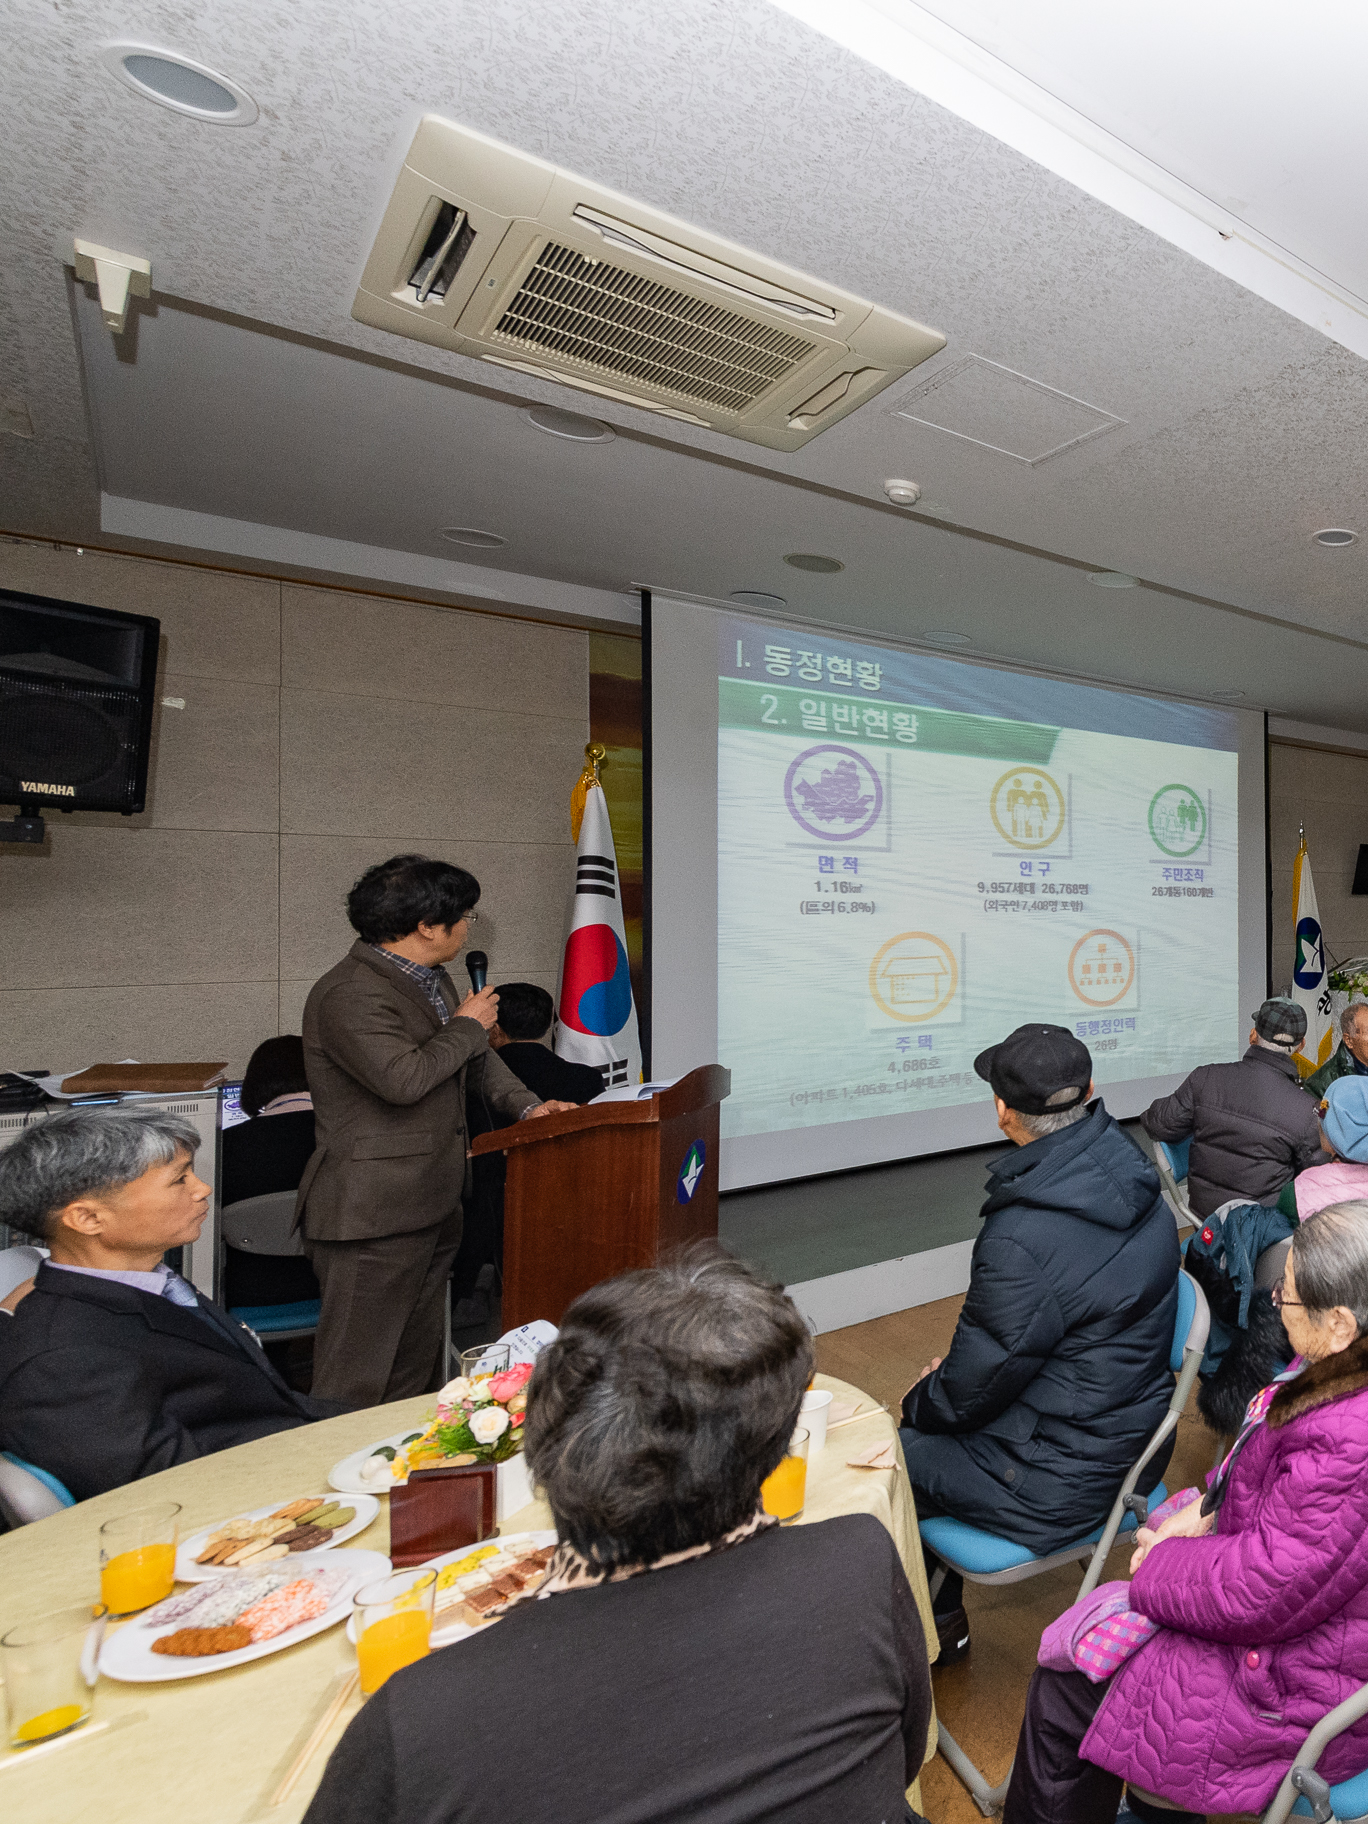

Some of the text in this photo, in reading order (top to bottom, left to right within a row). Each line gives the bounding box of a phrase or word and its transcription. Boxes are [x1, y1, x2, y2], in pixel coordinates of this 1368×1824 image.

[763, 645, 883, 692] 동정현황
[760, 693, 919, 744] 2. 일반현황
[21, 781, 75, 797] YAMAHA
[1161, 867, 1205, 882] 주민조직
[1076, 1017, 1136, 1038] 동행정인력
